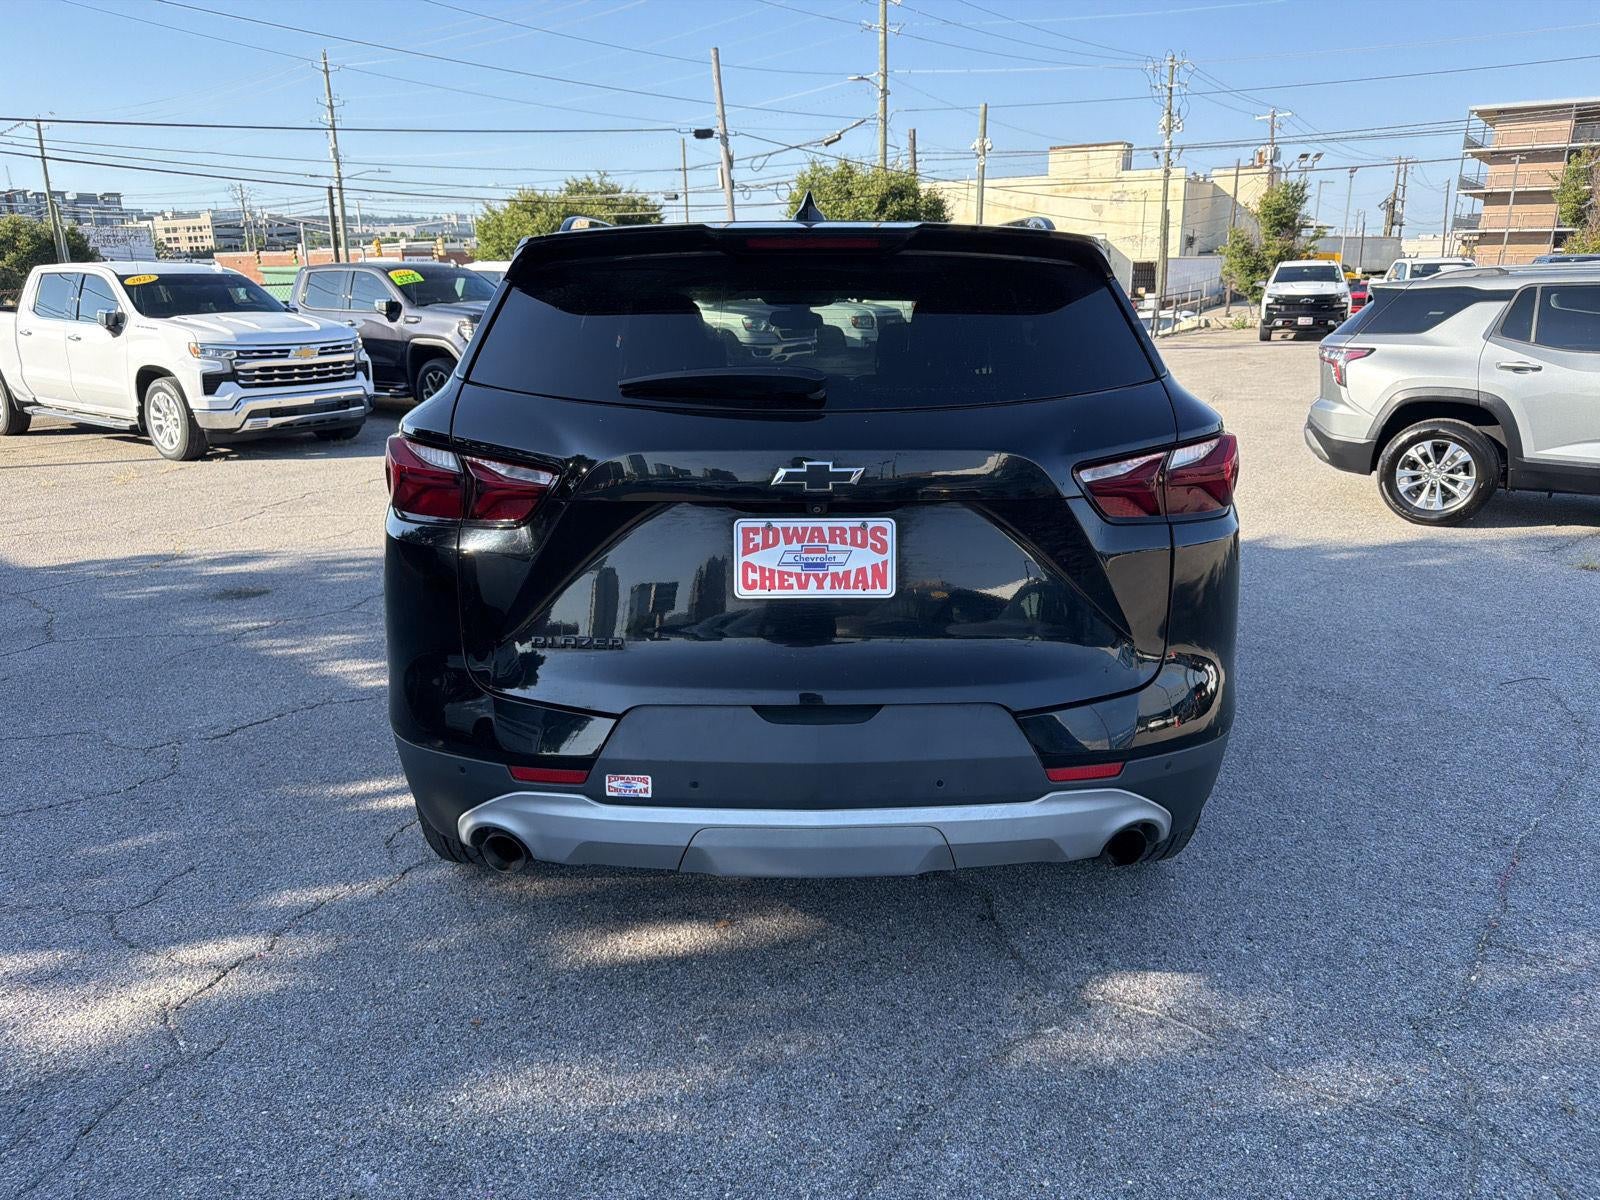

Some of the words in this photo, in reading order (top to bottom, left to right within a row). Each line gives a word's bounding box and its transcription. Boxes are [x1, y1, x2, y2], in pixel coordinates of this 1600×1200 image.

[741, 525, 888, 557] EDWARDS
[741, 559, 888, 590] CHEVYMAN
[531, 636, 624, 649] BLAZER
[607, 776, 649, 785] EDWARDS
[607, 785, 649, 794] CHEVYMAN
